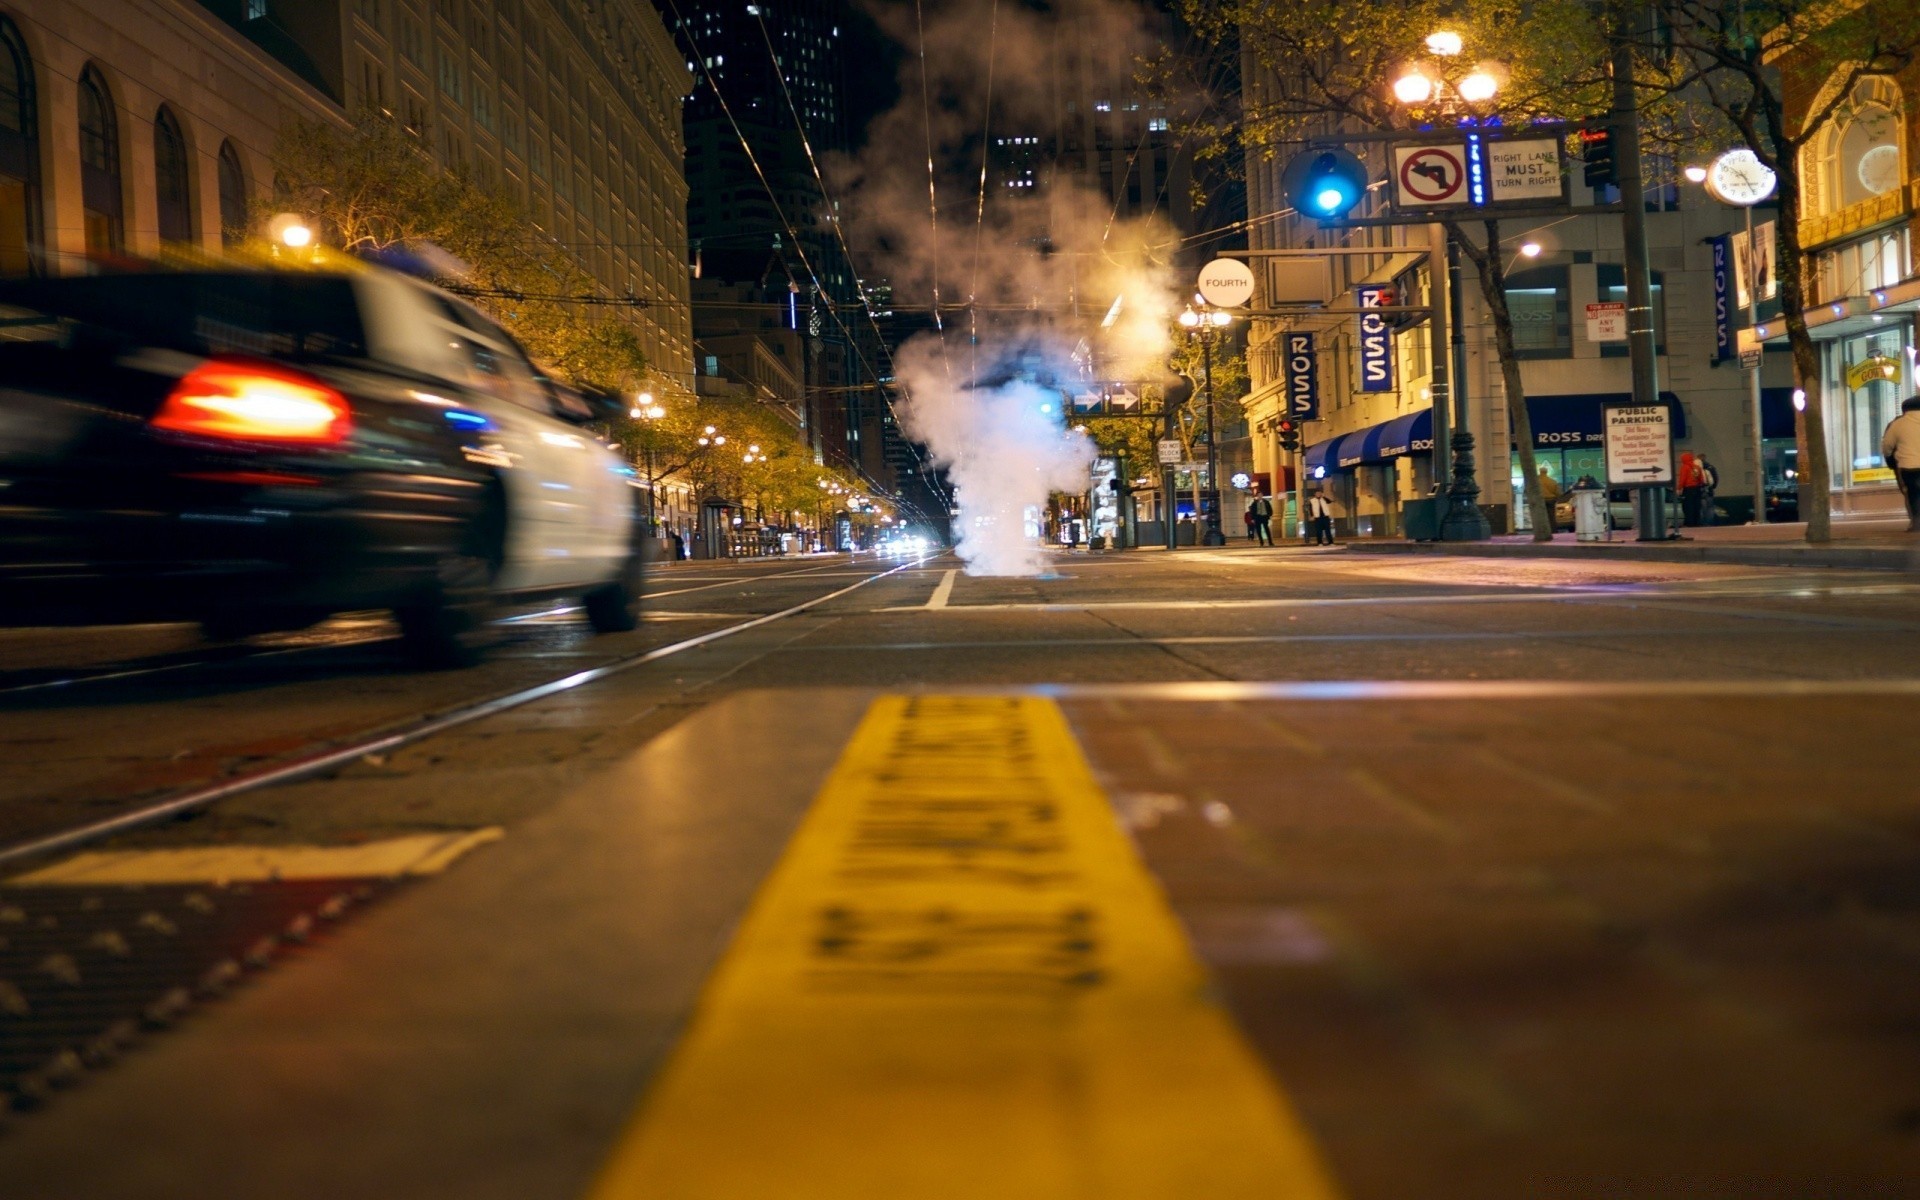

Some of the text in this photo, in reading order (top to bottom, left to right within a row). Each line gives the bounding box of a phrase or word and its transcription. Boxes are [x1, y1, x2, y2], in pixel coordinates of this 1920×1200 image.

[1493, 151, 1555, 163] RIGHT LANE
[1505, 163, 1544, 175] MUST
[1496, 176, 1557, 188] TURN RIGHT
[1206, 279, 1248, 287] FOURTH
[1715, 243, 1728, 348] ROSS
[1362, 290, 1387, 381] ROSS
[1291, 336, 1312, 412] ROSS
[1617, 407, 1657, 416] PUBLIC
[1611, 415, 1664, 425] PARKING
[1538, 432, 1582, 443] ROSS
